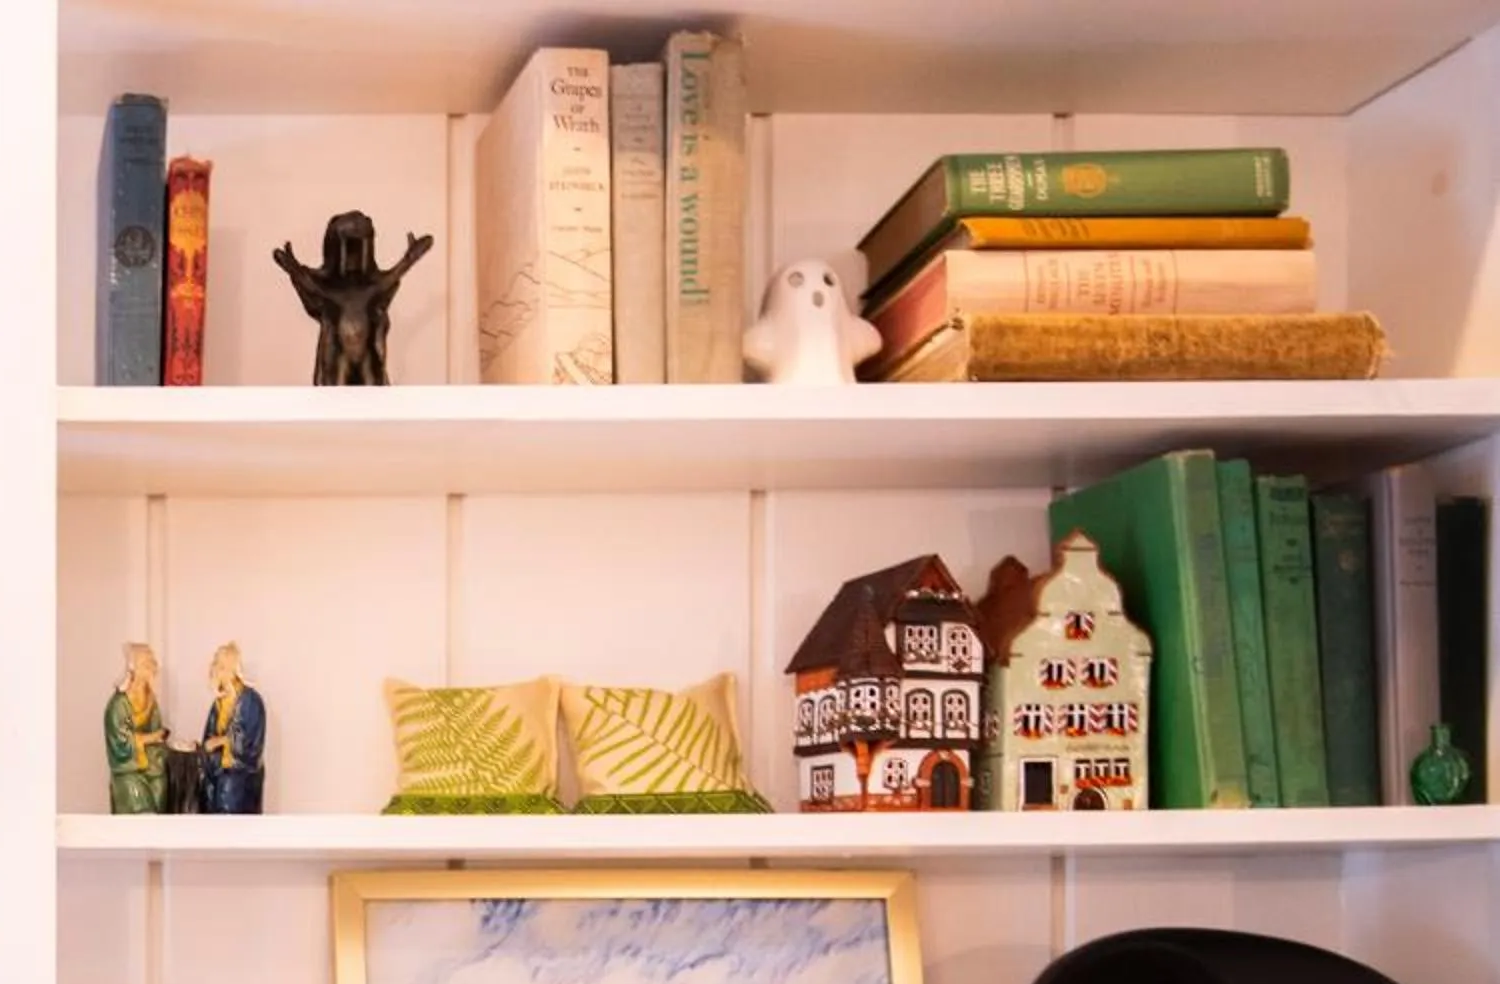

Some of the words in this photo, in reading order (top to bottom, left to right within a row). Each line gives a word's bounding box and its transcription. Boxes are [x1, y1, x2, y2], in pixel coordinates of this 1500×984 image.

[551, 78, 603, 101] Grapes
[680, 52, 710, 125] Love
[553, 115, 601, 133] Wrath
[680, 135, 710, 156] is
[680, 165, 699, 182] a
[967, 168, 987, 194] THE
[987, 162, 1007, 205] THREE
[680, 194, 710, 295] wound
